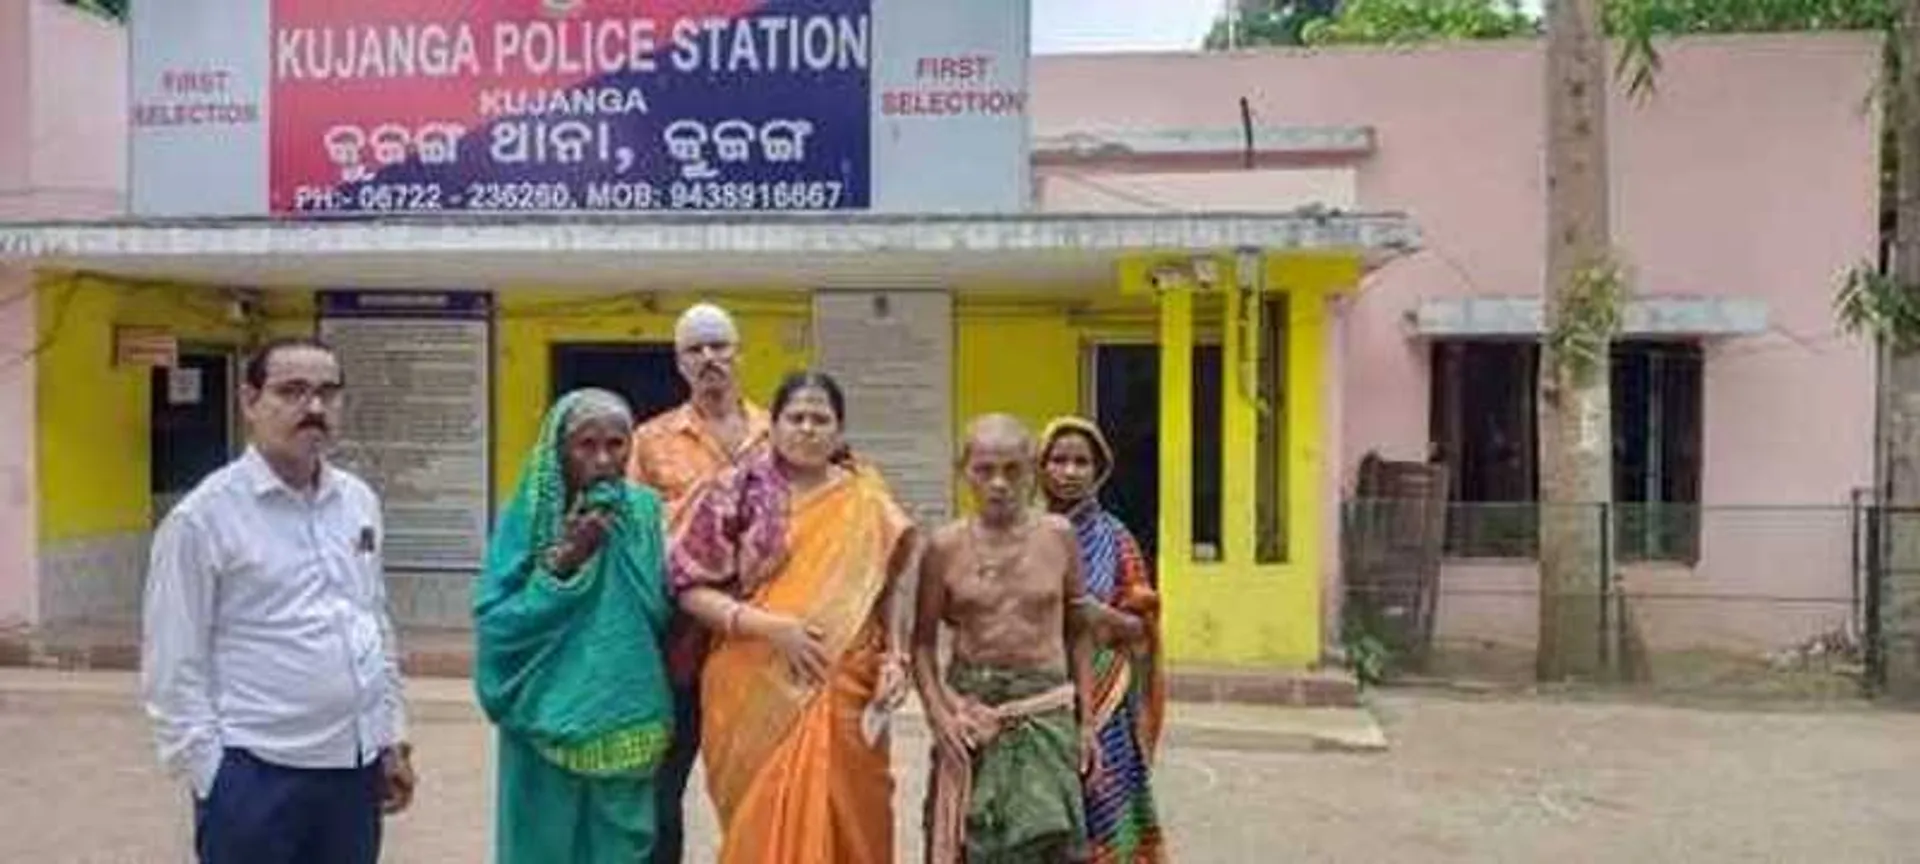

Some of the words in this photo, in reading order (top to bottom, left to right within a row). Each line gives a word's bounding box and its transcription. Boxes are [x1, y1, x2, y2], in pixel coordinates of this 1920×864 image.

[277, 26, 480, 78] KUJANGA
[494, 20, 655, 75] POLICE
[671, 14, 868, 72] STATION
[916, 56, 990, 79] FIRST
[162, 71, 231, 93] FIRST
[479, 87, 649, 117] KUJANGA
[881, 91, 1025, 115] SELECTION
[586, 181, 662, 209] MOB:
